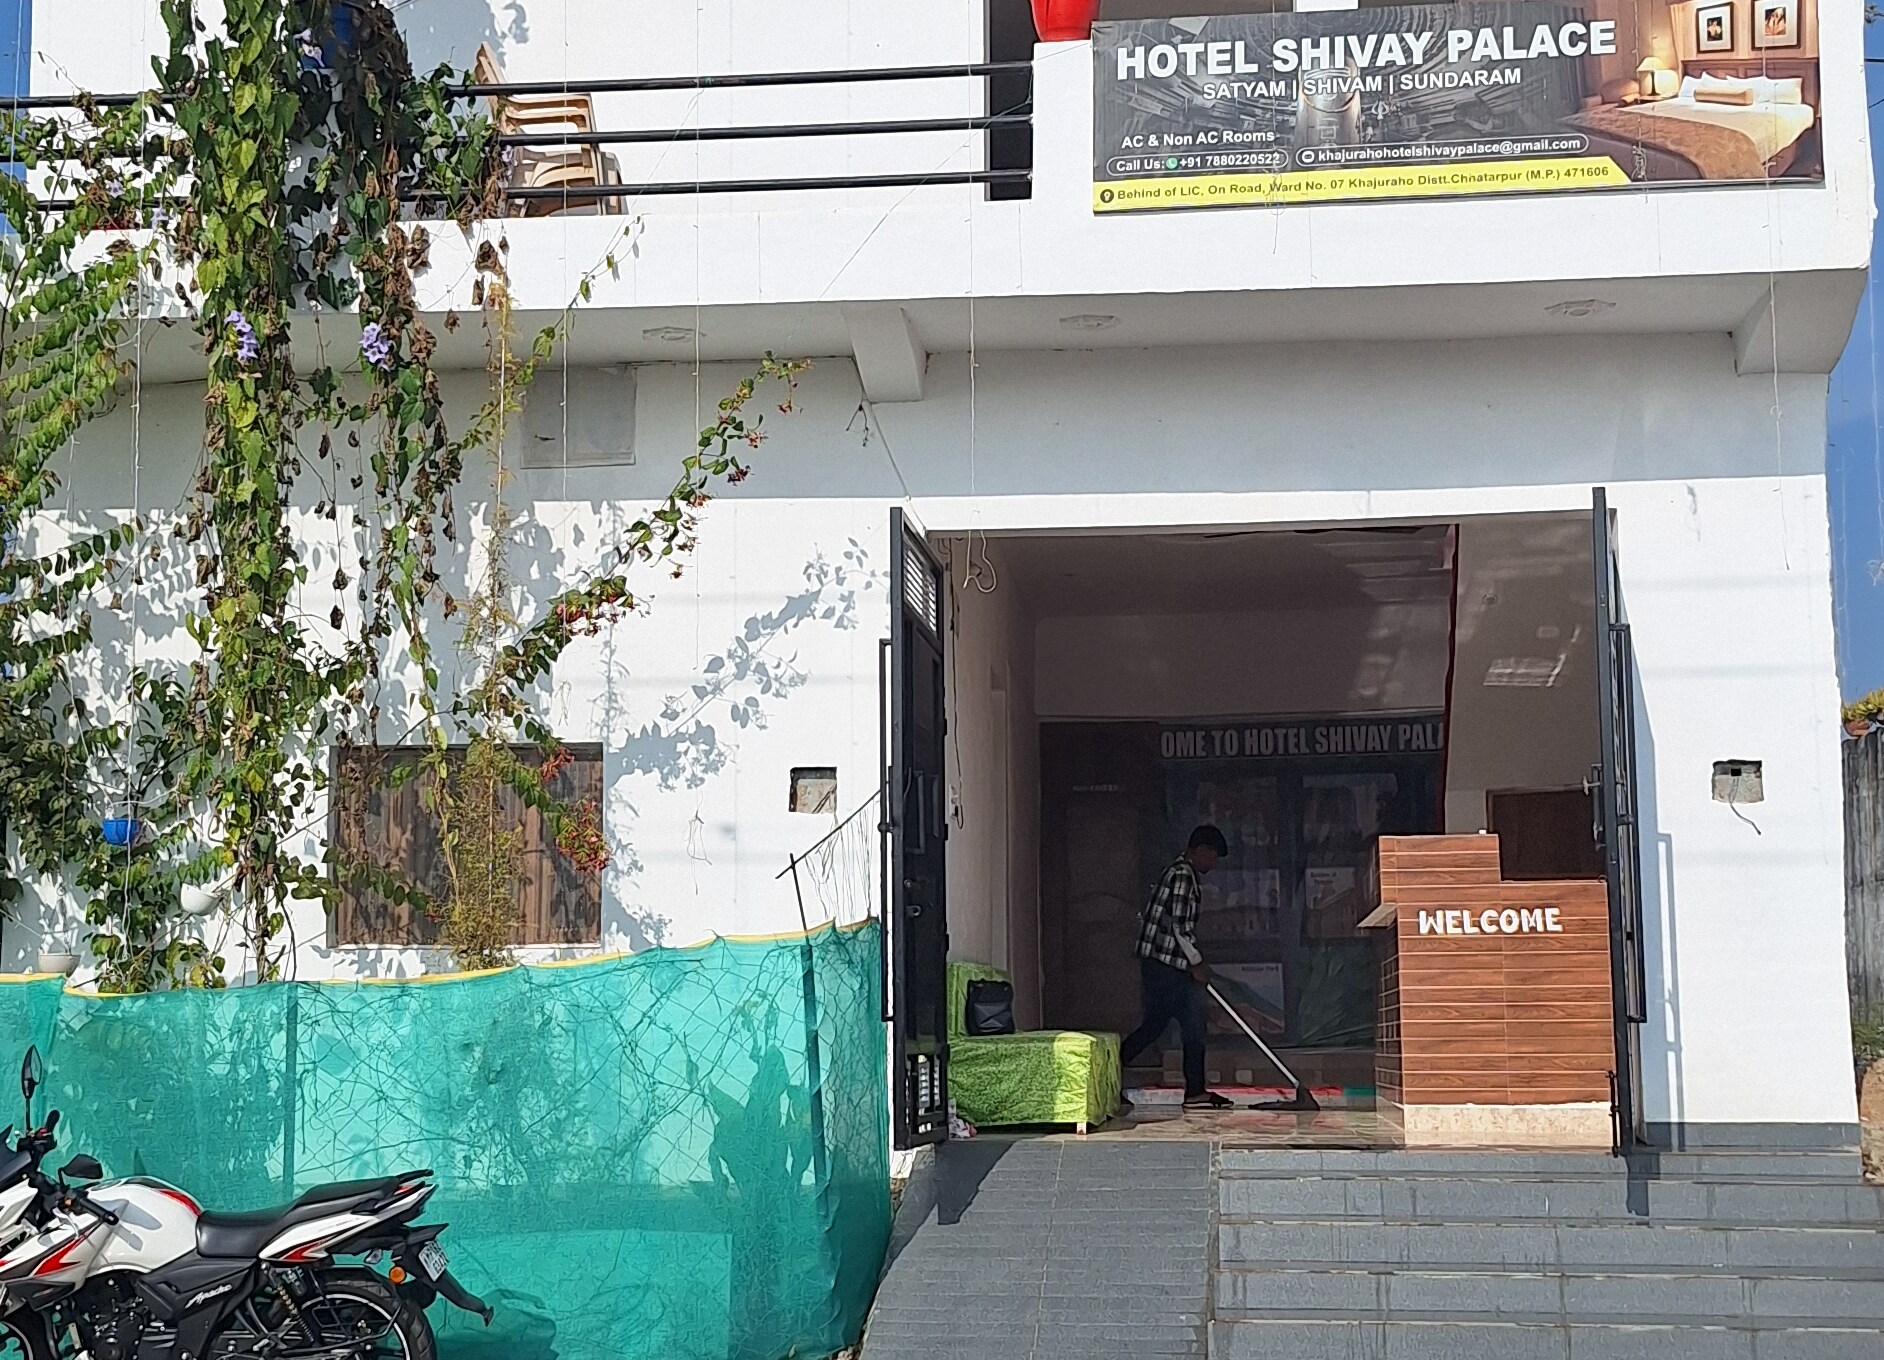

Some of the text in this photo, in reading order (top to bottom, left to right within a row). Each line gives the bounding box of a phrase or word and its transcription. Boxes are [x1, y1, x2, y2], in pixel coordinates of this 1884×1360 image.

[1117, 19, 1617, 80] HOTEL SHIVAY PALACE
[1203, 79, 1286, 101] SATYAM
[1303, 75, 1383, 96] SHIVAM
[1400, 68, 1521, 90] SUNDARAM
[1116, 159, 1140, 172] Call
[1144, 158, 1165, 170] Us:
[1179, 156, 1201, 168] +91
[1318, 138, 1581, 163] khajurahohotelshivaypalace@gmail.com
[1121, 130, 1275, 149] AC & Non AC Rooms
[1118, 187, 1161, 199] Behind
[1165, 186, 1177, 196] of
[1208, 185, 1226, 195] On
[1230, 183, 1265, 194] Road,
[1269, 182, 1302, 193] Ward
[1306, 181, 1327, 191] No.
[1330, 179, 1345, 189] 07
[1349, 176, 1414, 190] Khajuraho
[1563, 166, 1609, 178] 471606
[1212, 730, 1239, 758] TO
[1244, 727, 1310, 757] HOTEL
[1314, 724, 1392, 755] SHIVAY
[1418, 906, 1564, 935] WELCOME
